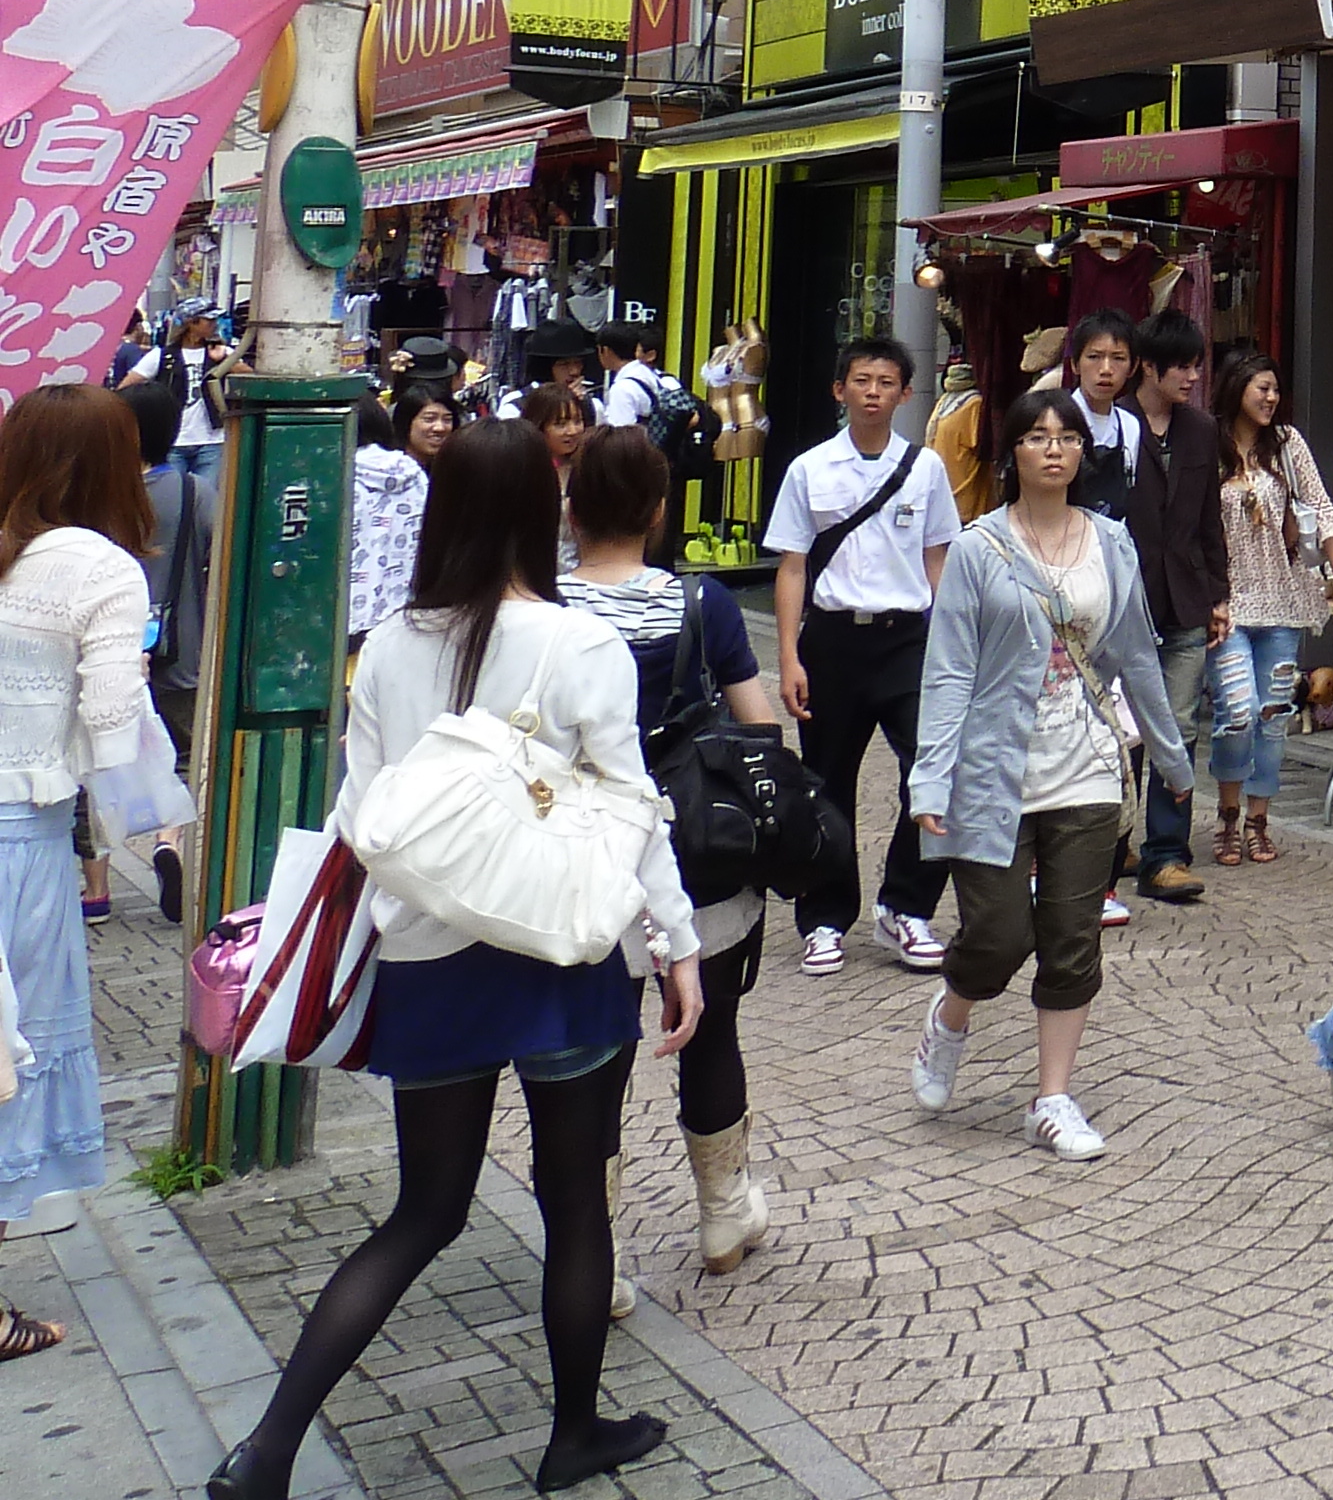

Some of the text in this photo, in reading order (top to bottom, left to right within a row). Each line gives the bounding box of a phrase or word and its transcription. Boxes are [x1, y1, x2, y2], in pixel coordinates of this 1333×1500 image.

[861, 12, 886, 36] inner
[520, 44, 617, 62] www.bodyfocus.jp
[624, 301, 656, 325] BF
